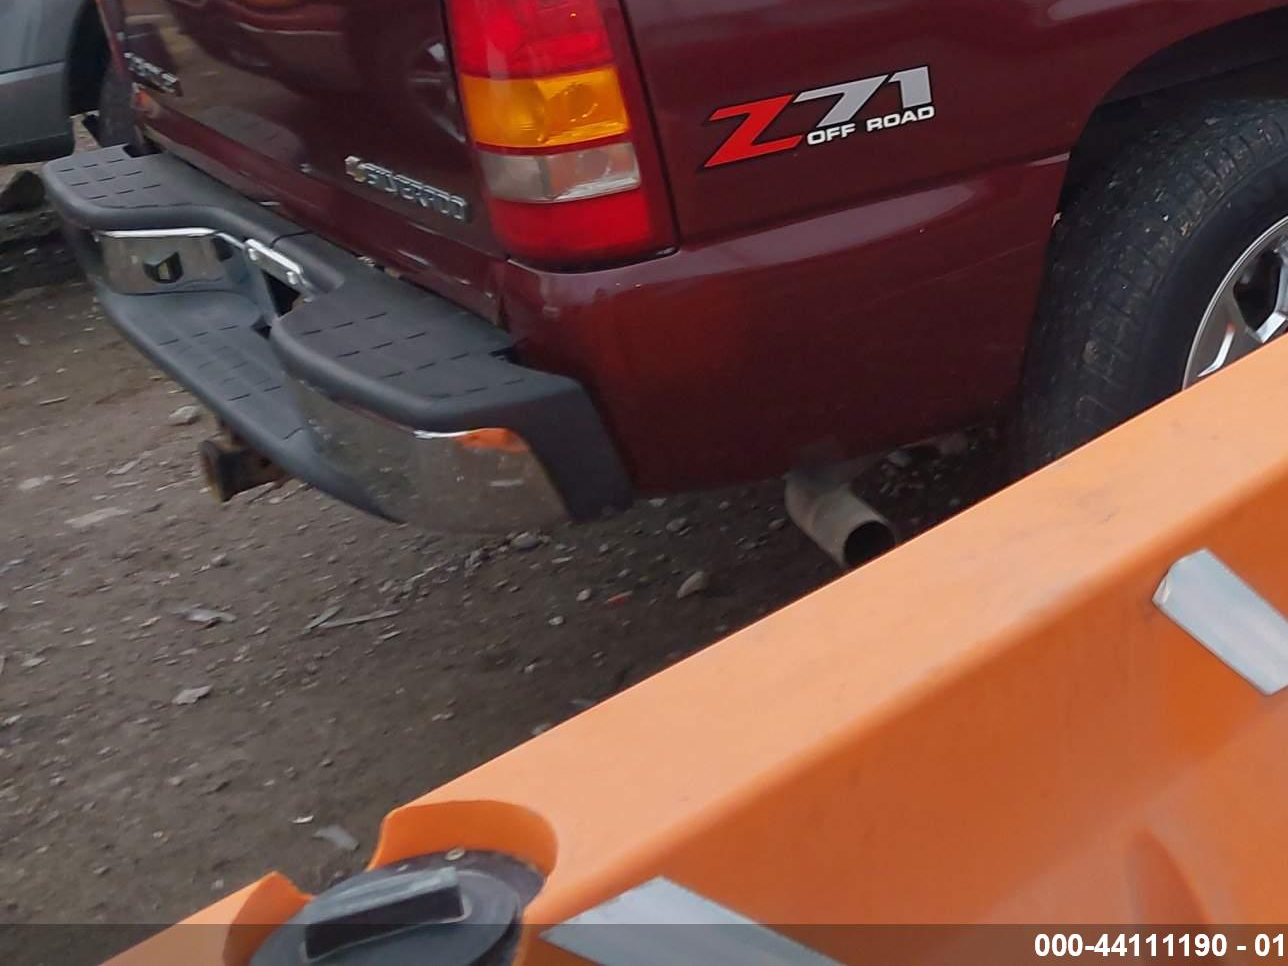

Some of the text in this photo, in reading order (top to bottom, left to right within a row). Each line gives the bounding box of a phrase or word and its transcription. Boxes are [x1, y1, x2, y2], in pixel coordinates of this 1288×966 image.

[704, 65, 932, 167] Z71
[806, 105, 935, 146] OFF ROAD
